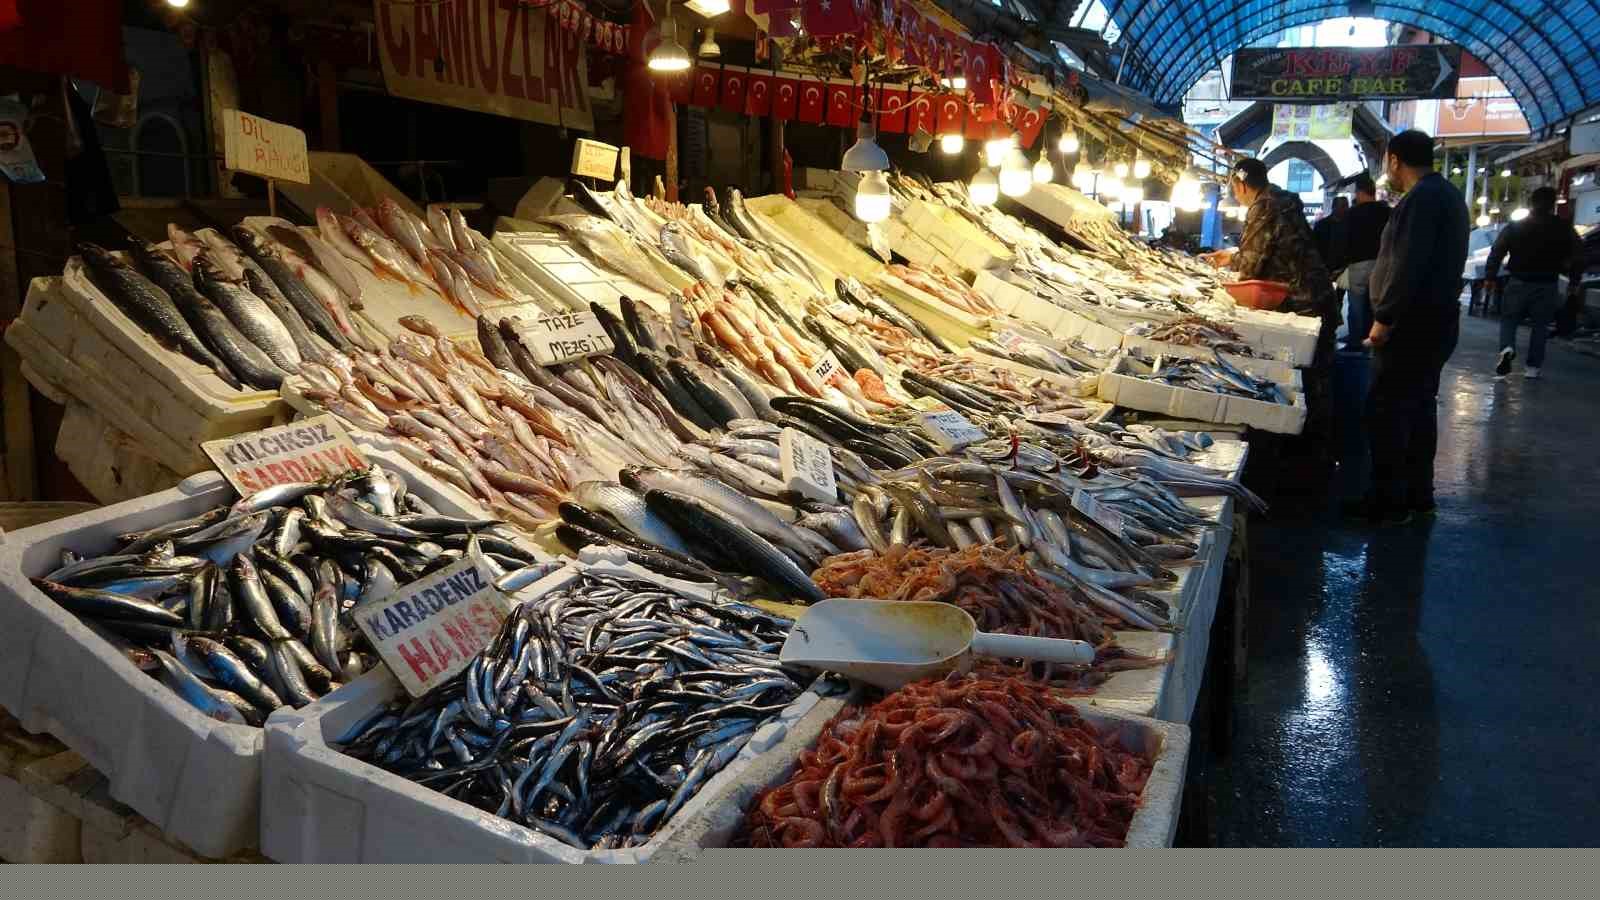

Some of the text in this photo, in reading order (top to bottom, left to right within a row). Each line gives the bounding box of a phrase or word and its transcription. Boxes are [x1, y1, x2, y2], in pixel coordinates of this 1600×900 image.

[1281, 50, 1415, 77] KEYF
[1351, 78, 1408, 96] BAR
[538, 314, 585, 332] TAZE
[548, 334, 607, 361] MEZGİT
[815, 359, 833, 379] TAZE
[366, 566, 490, 641] KARADENİZ
